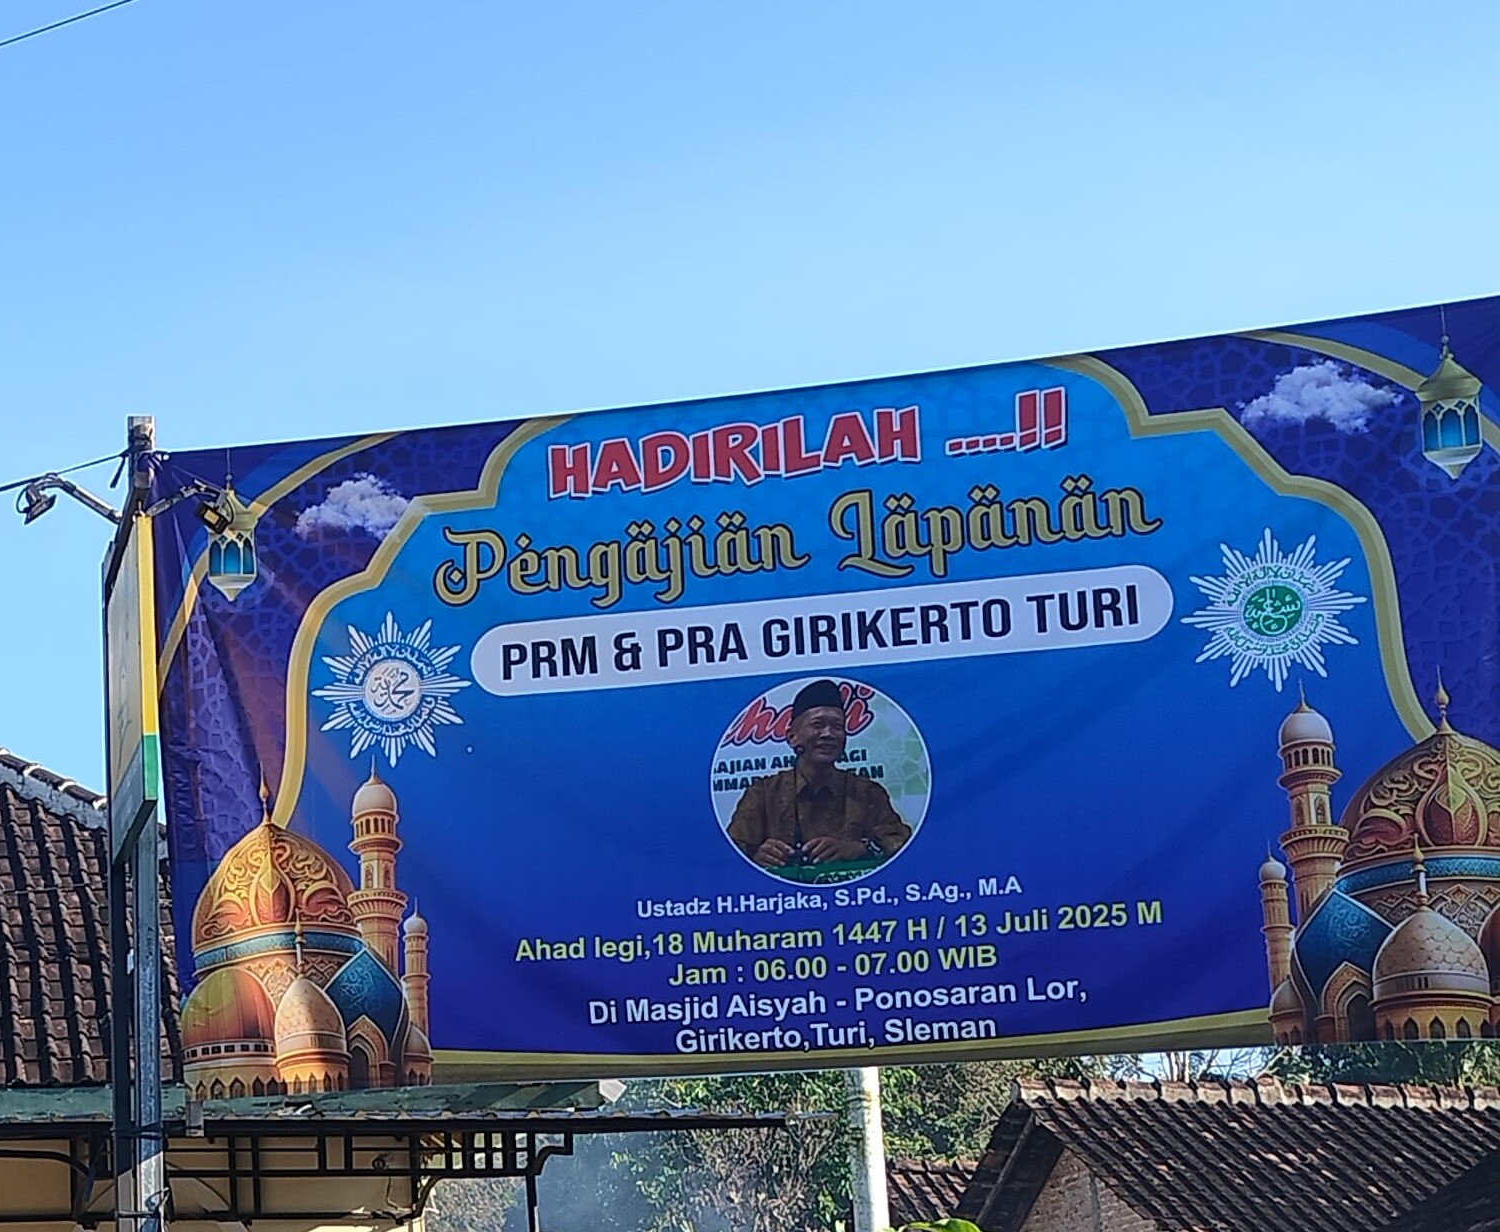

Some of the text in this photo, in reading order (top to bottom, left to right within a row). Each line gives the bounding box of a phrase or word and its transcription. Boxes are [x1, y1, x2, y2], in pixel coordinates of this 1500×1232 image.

[549, 405, 920, 501] HADIRILAH
[502, 585, 1139, 680] PRM & PRA GIRIKERTO TURI
[713, 757, 766, 774] AJIAN
[637, 876, 1022, 918] Ustadz H.Harjaka, S.Pd., S.Ag., M.A
[515, 937, 585, 961] Ahad
[693, 929, 822, 953] Muharam
[832, 920, 897, 945] 1447
[907, 918, 927, 940] H
[937, 916, 945, 939] /
[955, 914, 987, 937] 13
[996, 908, 1048, 934] Juli
[1057, 903, 1127, 929] 2025
[1137, 901, 1162, 924] M
[669, 964, 726, 986] Jam
[753, 957, 827, 981] 06.00
[854, 950, 929, 976] 07.00
[937, 944, 997, 970] WIB
[589, 1000, 617, 1024] Di
[626, 996, 718, 1025] Masjid
[726, 991, 826, 1021] Aisyah
[854, 980, 1017, 1011] Ponosaran
[1027, 977, 1087, 1003] Lor,
[885, 1018, 996, 1044] Sleman
